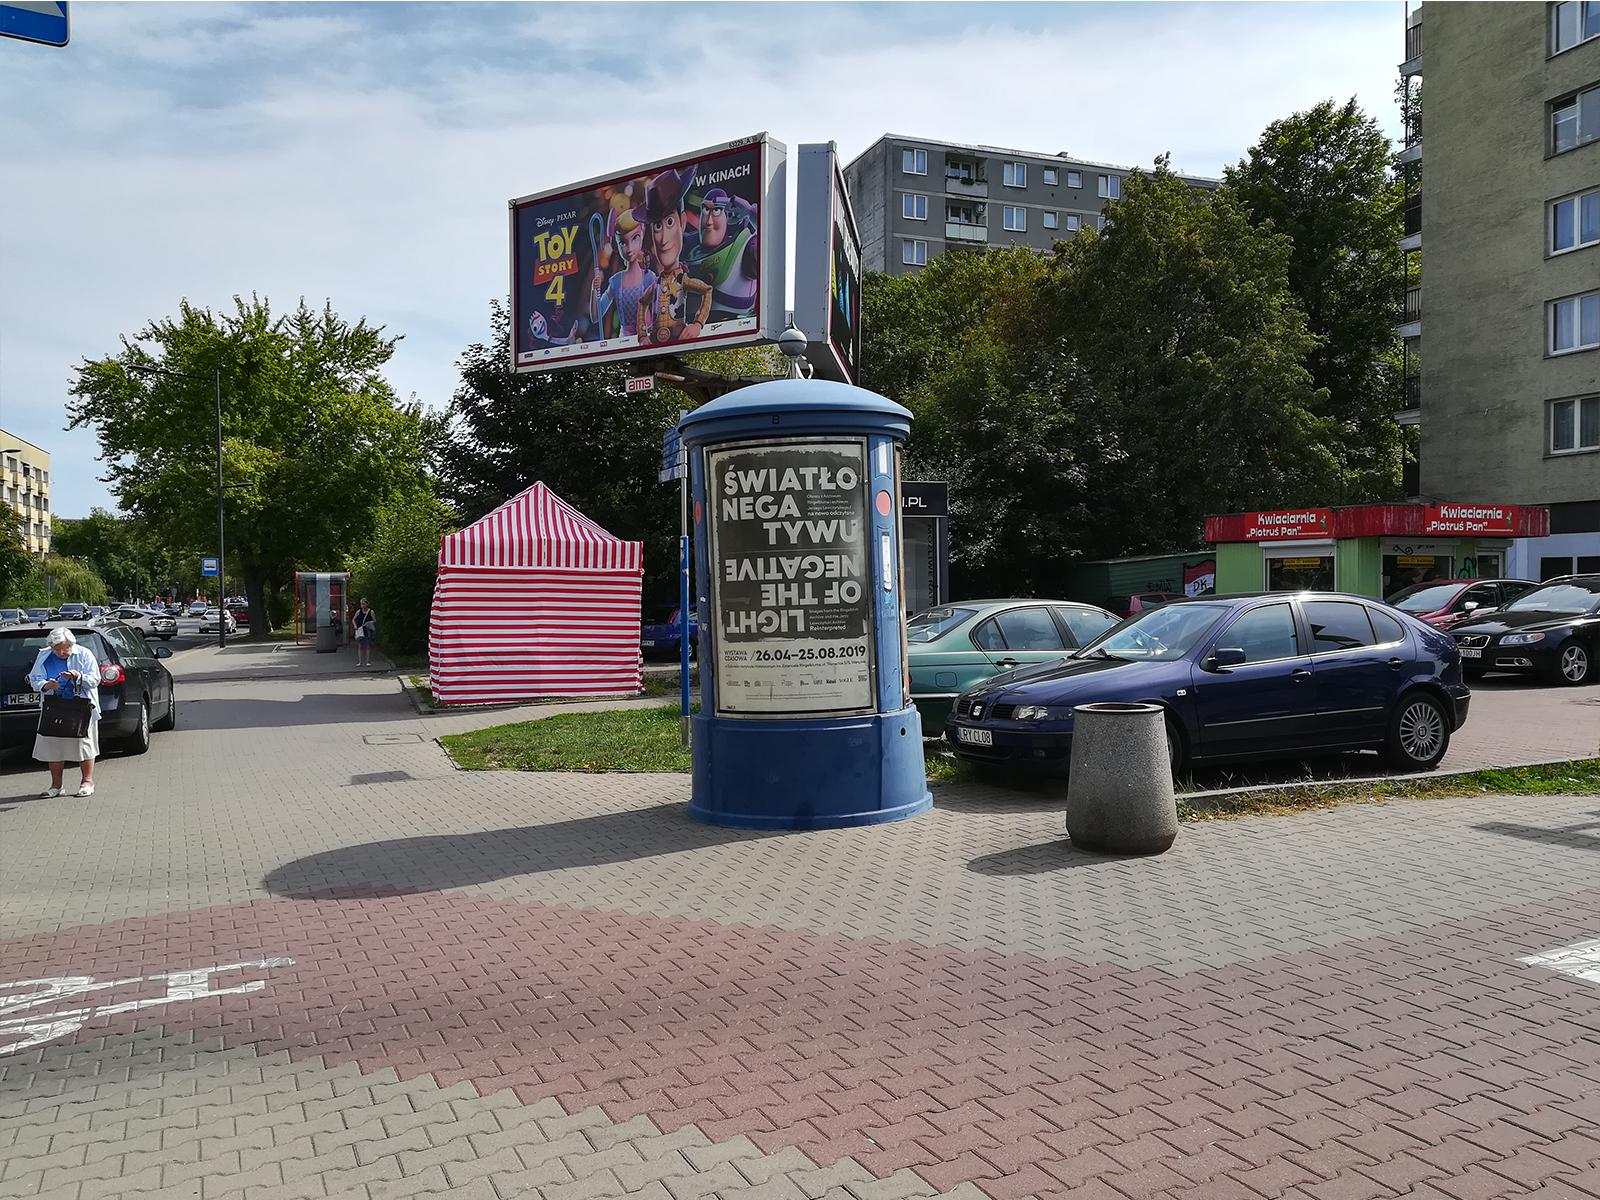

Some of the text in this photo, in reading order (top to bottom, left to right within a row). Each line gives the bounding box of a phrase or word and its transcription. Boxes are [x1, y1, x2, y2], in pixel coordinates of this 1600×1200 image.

[695, 164, 751, 187] W KINACH
[536, 211, 577, 228] Disney PIXAR
[534, 225, 579, 261] TOY
[538, 259, 574, 275] STORY
[545, 275, 565, 306] 4
[628, 378, 651, 391] ams
[723, 465, 858, 495] ŚWIATŁO
[722, 494, 802, 522] NEGA
[1257, 511, 1317, 525] Kwiaciarnia
[1440, 505, 1503, 520] Kwiaciarnia
[763, 519, 859, 545] TYWU
[725, 554, 861, 582] NEGATIVE
[761, 580, 862, 607] OF THE
[726, 609, 805, 634] LIGHT
[10, 694, 25, 704] WE
